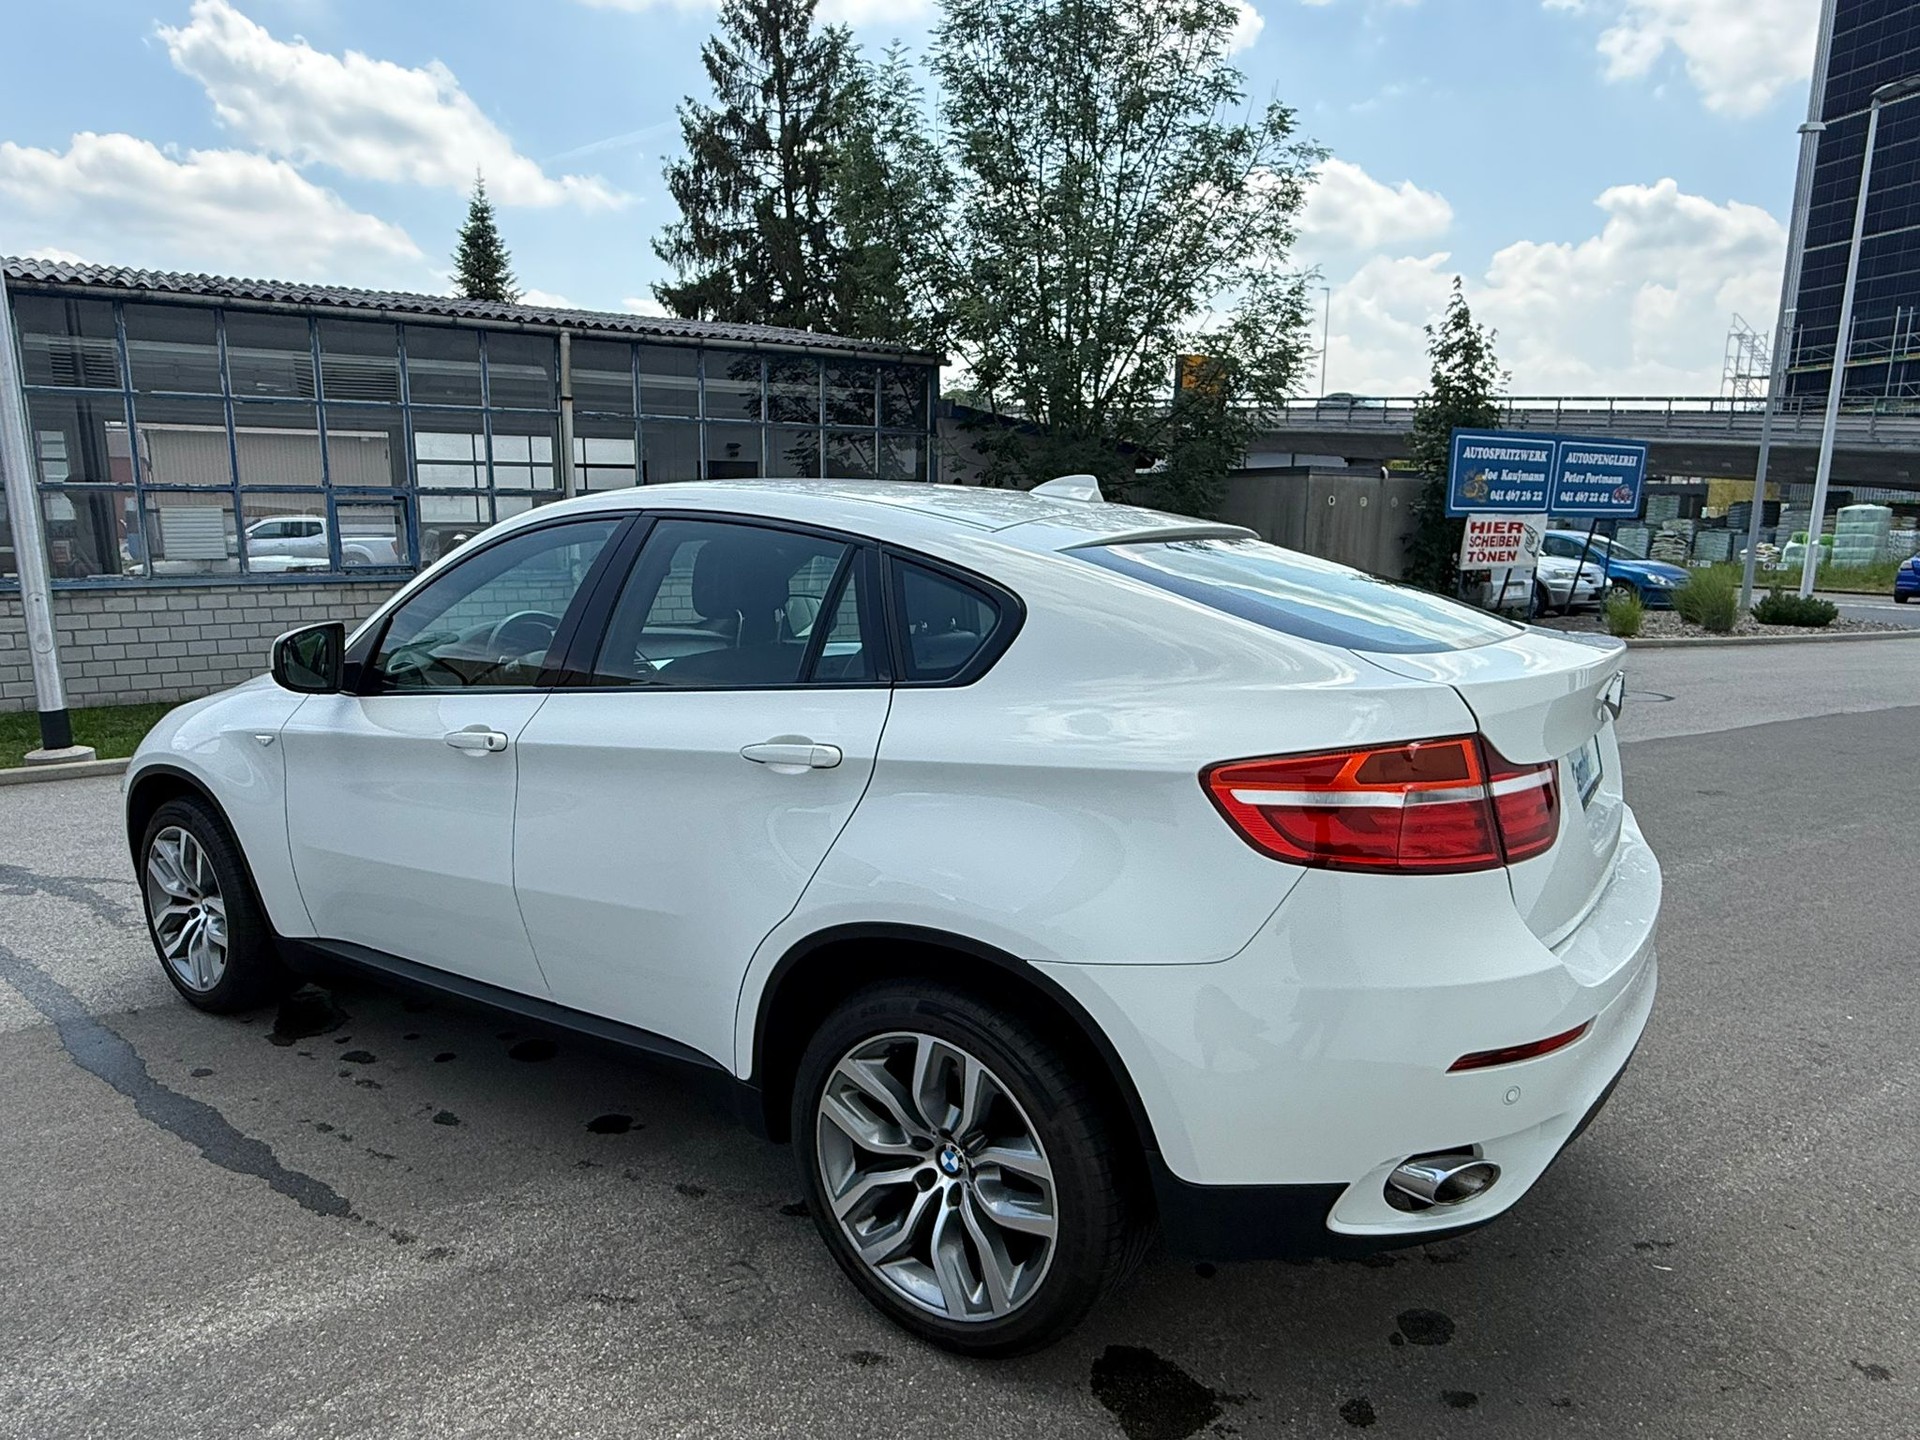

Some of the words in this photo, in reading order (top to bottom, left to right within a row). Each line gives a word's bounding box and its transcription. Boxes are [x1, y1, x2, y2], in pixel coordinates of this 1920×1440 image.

[1463, 446, 1548, 462] AUTOSPRITZWERK
[1565, 452, 1638, 467] AUTOSPENGLEREI
[1482, 468, 1498, 480] Joe
[1501, 469, 1545, 483] Kaufmann
[1563, 471, 1585, 483] Peter
[1585, 472, 1623, 484] Portmann
[1490, 490, 1505, 501] 041
[1505, 490, 1520, 502] 467
[1521, 490, 1532, 501] 26
[1560, 491, 1574, 502] 041
[1470, 522, 1524, 534] HIER
[1469, 535, 1521, 548] SCHEIBEN
[1467, 548, 1517, 562] TÖNEN
